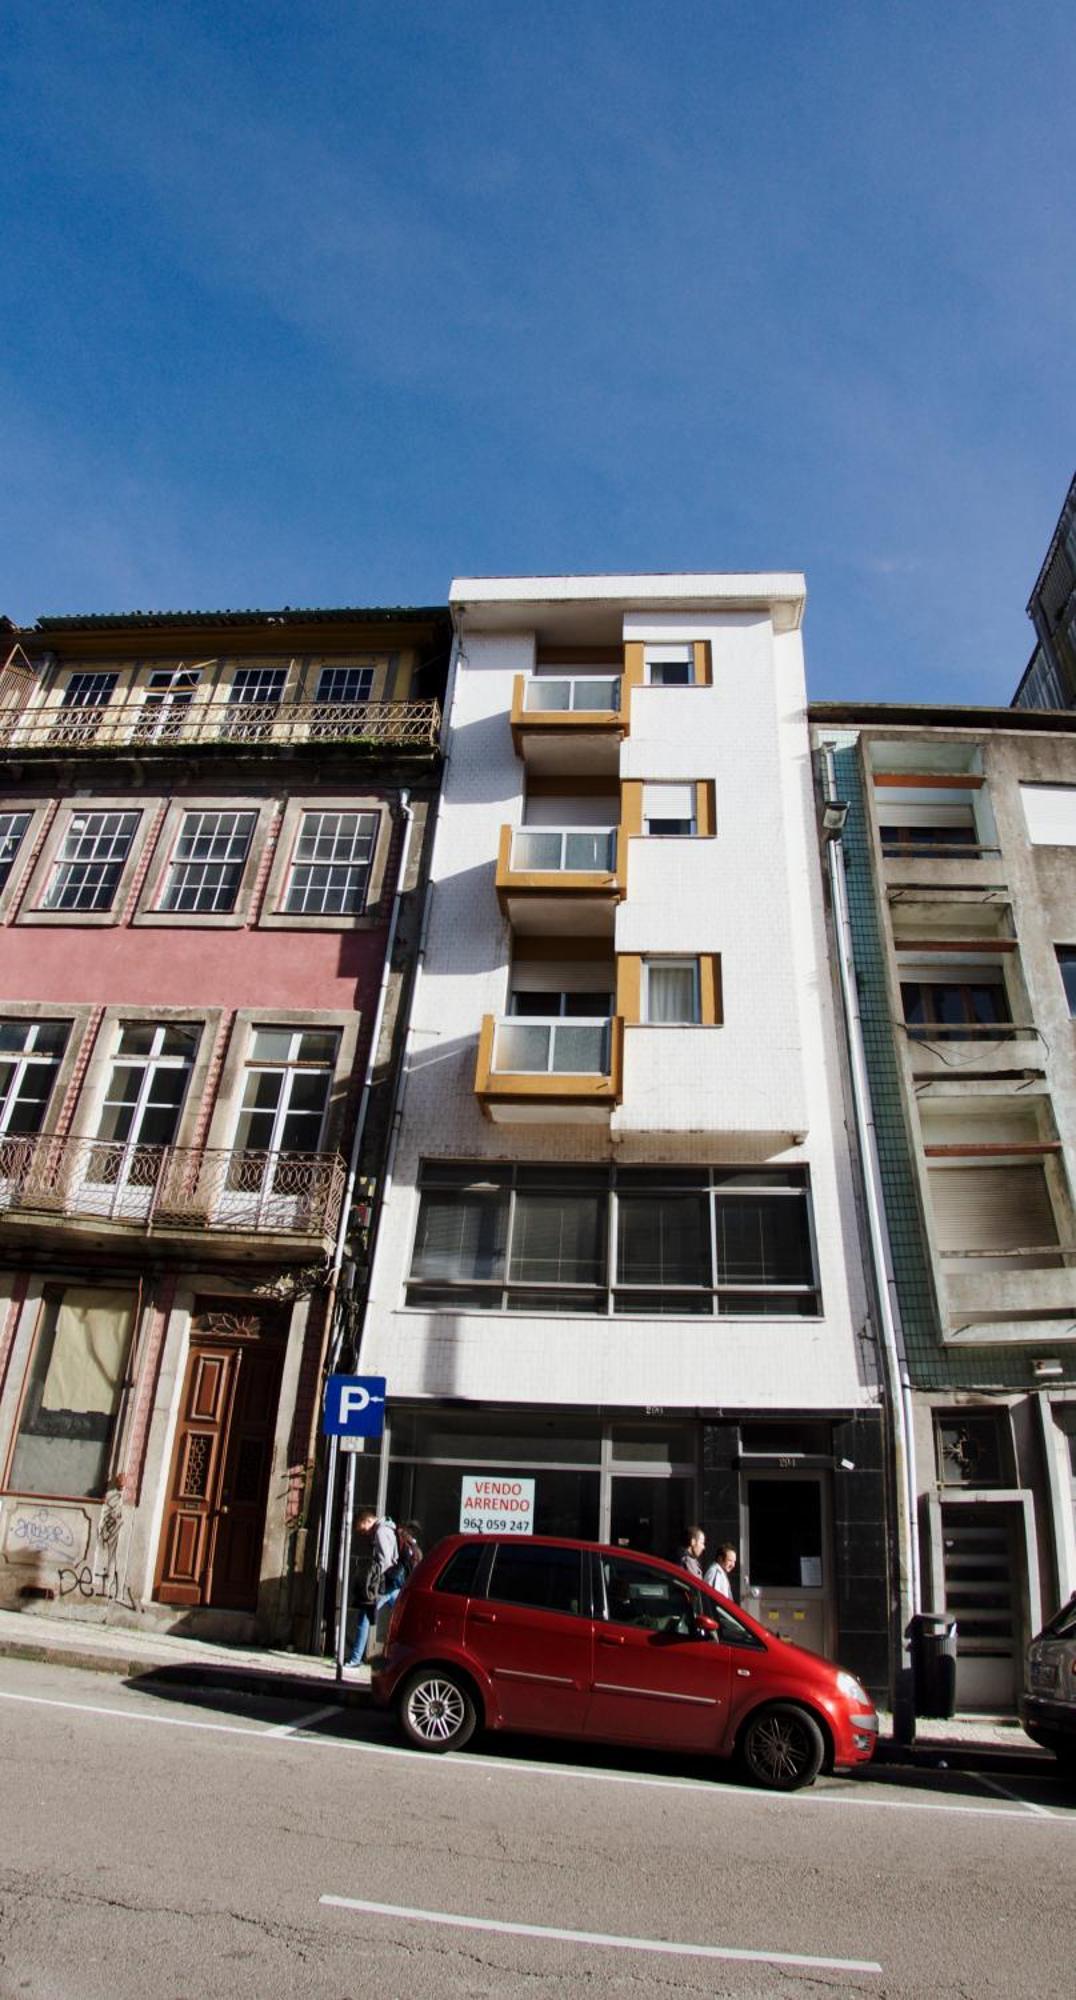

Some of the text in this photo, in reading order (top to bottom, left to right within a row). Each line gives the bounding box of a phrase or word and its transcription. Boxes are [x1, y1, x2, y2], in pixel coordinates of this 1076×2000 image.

[338, 1385, 370, 1424] P
[474, 1482, 522, 1496] VENDO
[464, 1496, 530, 1512] ARRENDO
[463, 1518, 530, 1532] 962 059 247
